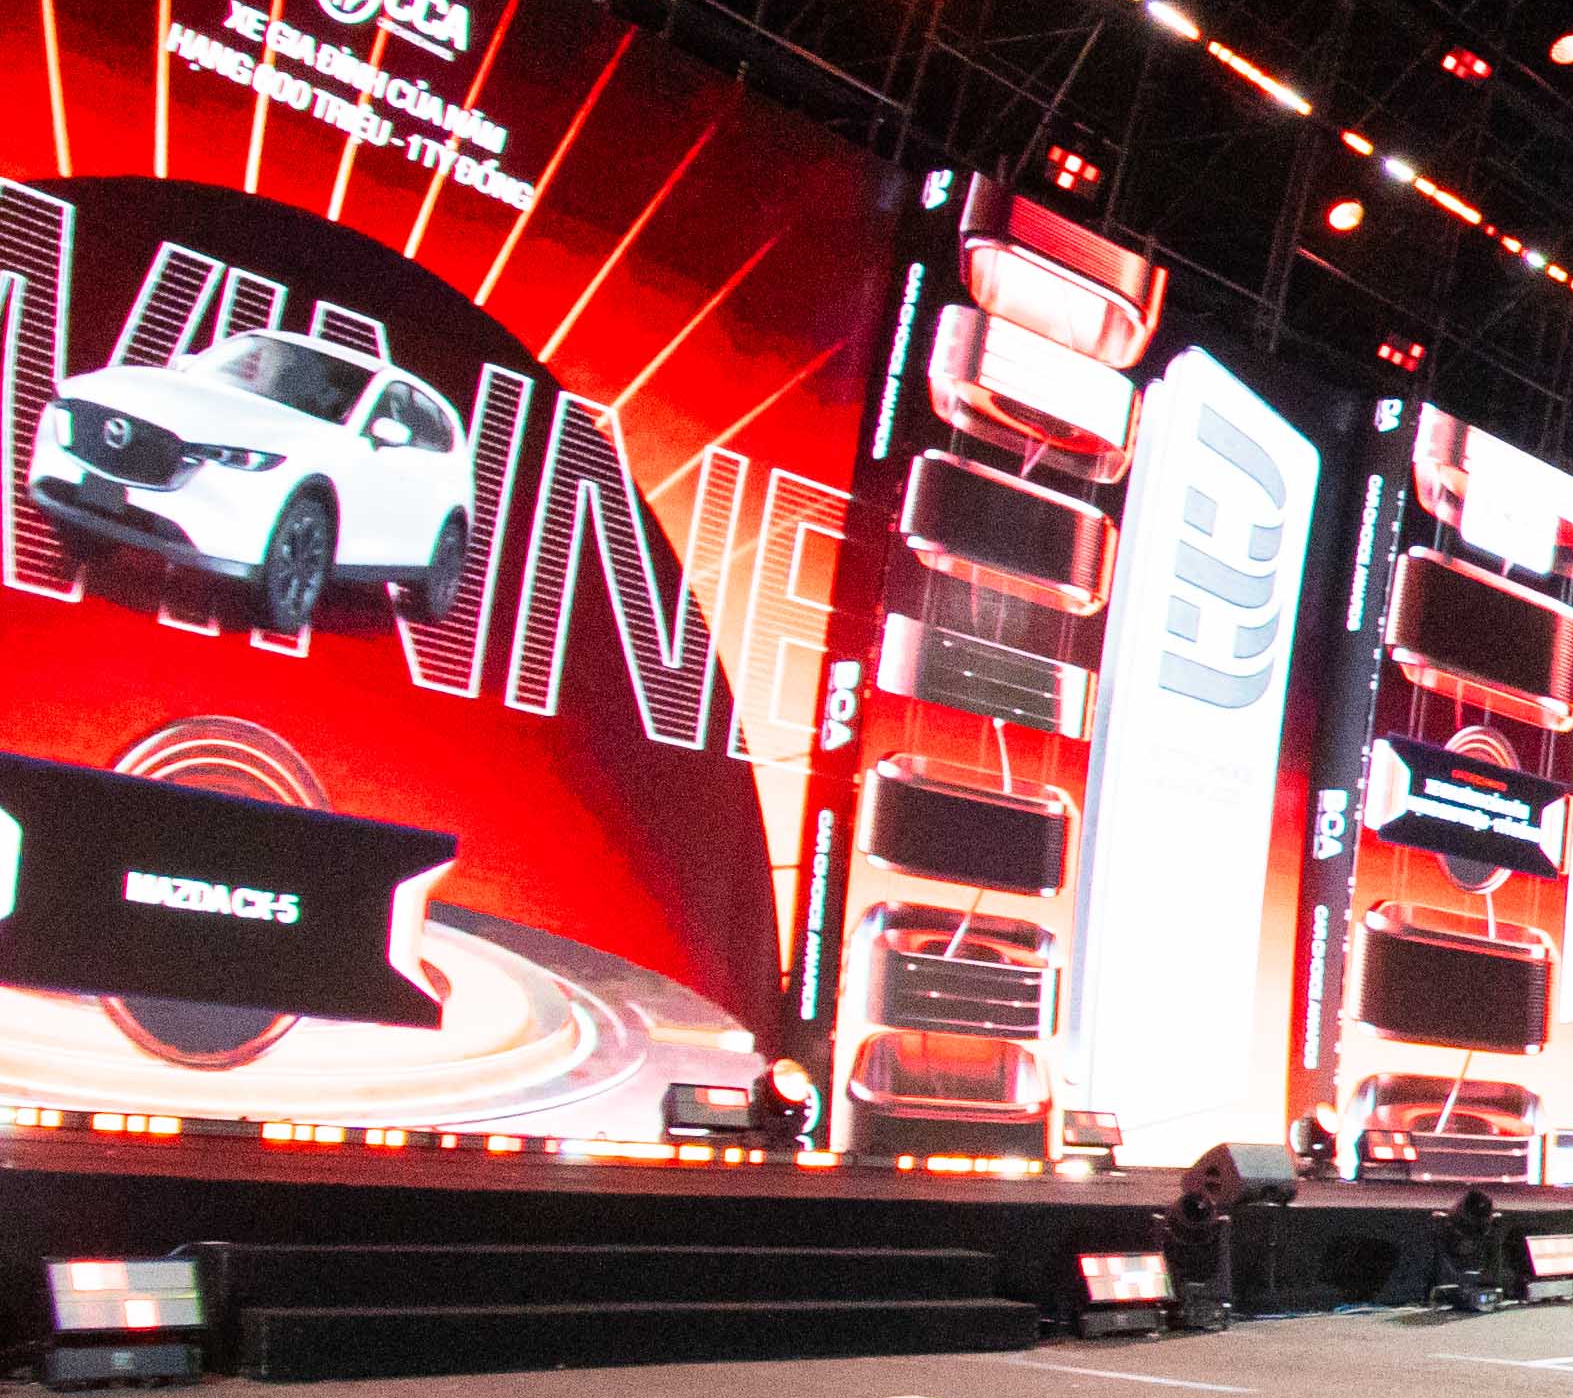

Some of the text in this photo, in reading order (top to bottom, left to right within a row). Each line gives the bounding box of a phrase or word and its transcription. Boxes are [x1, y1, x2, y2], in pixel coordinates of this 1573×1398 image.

[166, 22, 255, 87] HẠNG
[312, 88, 393, 147] TRIỆU
[406, 134, 422, 161] 1
[223, 0, 269, 42] XE
[266, 20, 316, 66] GIA
[386, 78, 444, 127] CỦA
[443, 104, 508, 154] NĂM
[872, 262, 925, 459] CAR CHOICE AWARDS
[1346, 474, 1384, 632] CAR CHOICE AWARDS
[821, 660, 861, 751] BCA
[122, 871, 300, 924] MAZDA CX-5
[1313, 789, 1349, 860] BCA
[800, 809, 834, 1020] CAR CHOICE AWARDS
[1303, 904, 1329, 1070] CAR CHOICE AWARDS
